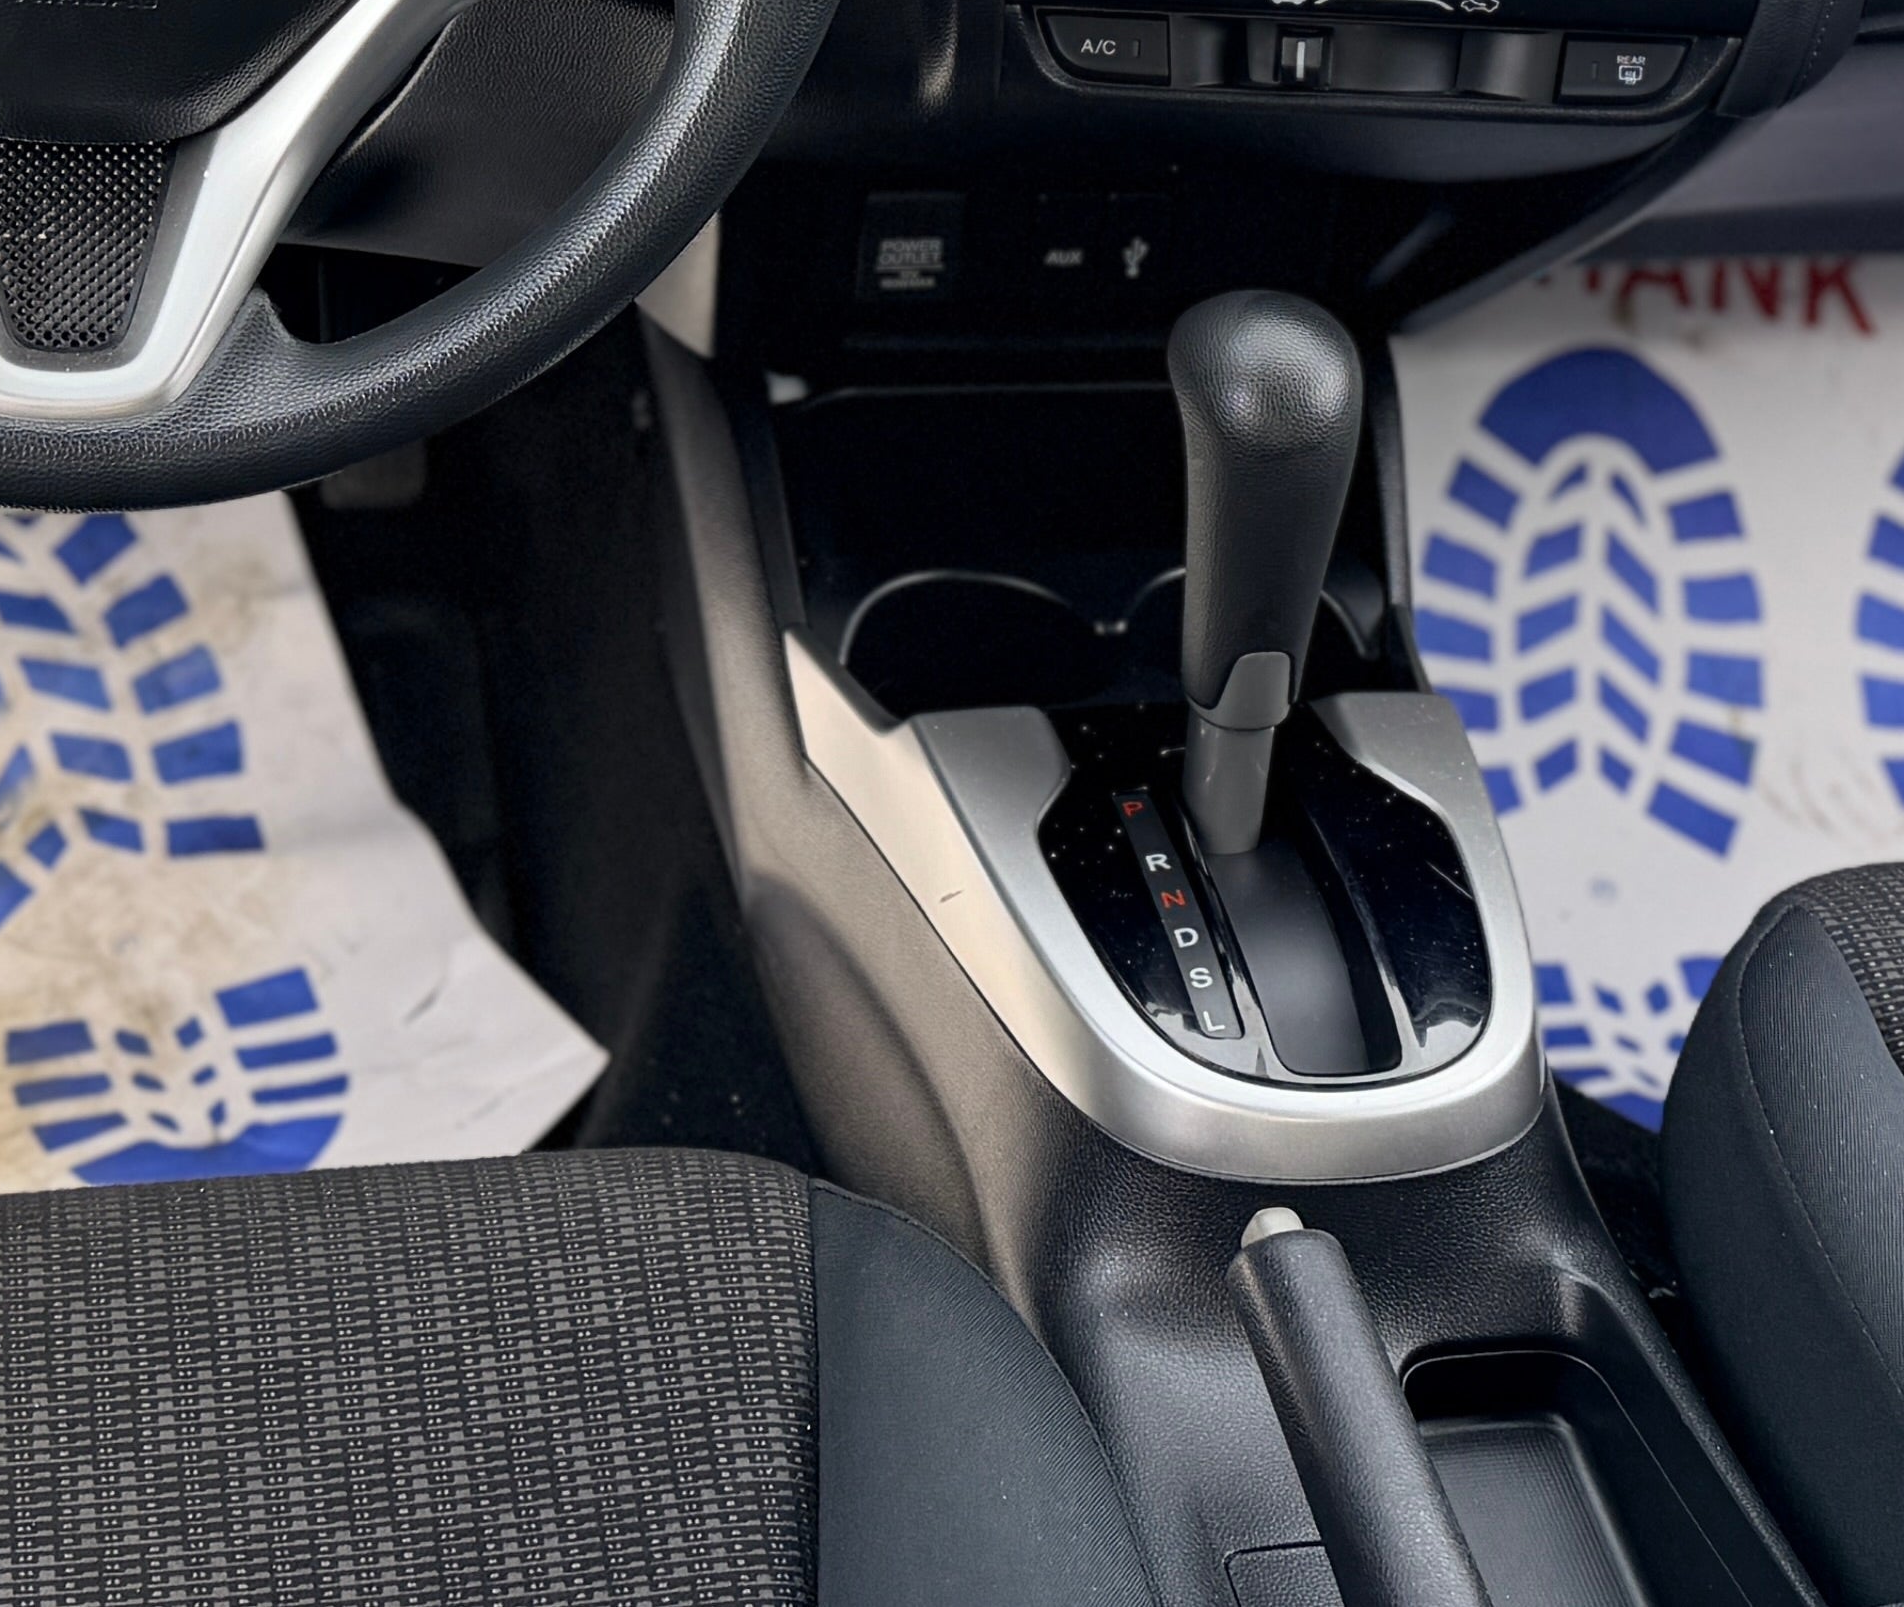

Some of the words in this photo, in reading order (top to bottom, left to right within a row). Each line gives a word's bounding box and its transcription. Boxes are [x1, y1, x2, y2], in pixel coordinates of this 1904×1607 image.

[1080, 39, 1117, 57] A/C
[1616, 55, 1646, 67] REAR
[882, 240, 940, 252] POWER
[879, 252, 940, 266] OUTLET
[1044, 251, 1083, 265] AUX
[1536, 257, 1876, 338] ANK
[1122, 801, 1145, 817] P
[1145, 853, 1172, 872] R
[1161, 889, 1186, 907] N
[1174, 928, 1199, 948] D
[1189, 967, 1214, 988] S
[1203, 1011, 1226, 1033] L
